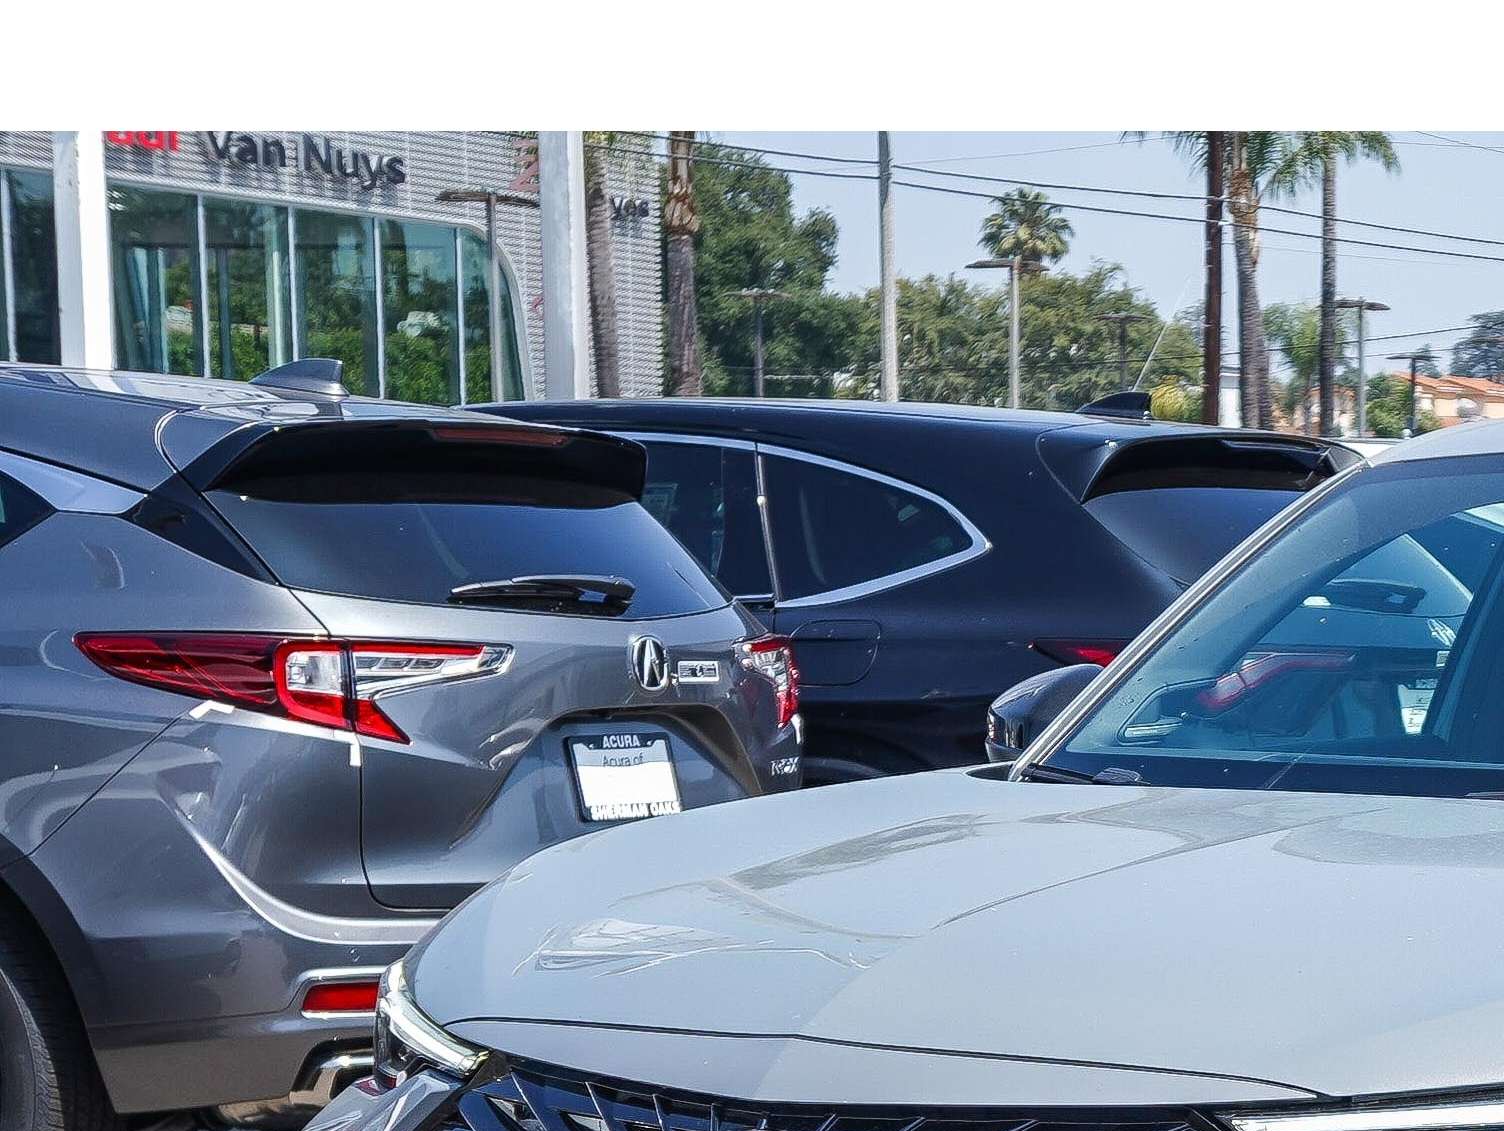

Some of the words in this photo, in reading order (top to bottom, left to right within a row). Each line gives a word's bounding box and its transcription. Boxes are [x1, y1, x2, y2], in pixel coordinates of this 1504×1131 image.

[202, 131, 287, 168] Van
[301, 134, 406, 190] Nuys
[602, 735, 641, 750] ACURA
[602, 754, 632, 768] Acura
[633, 751, 644, 765] of
